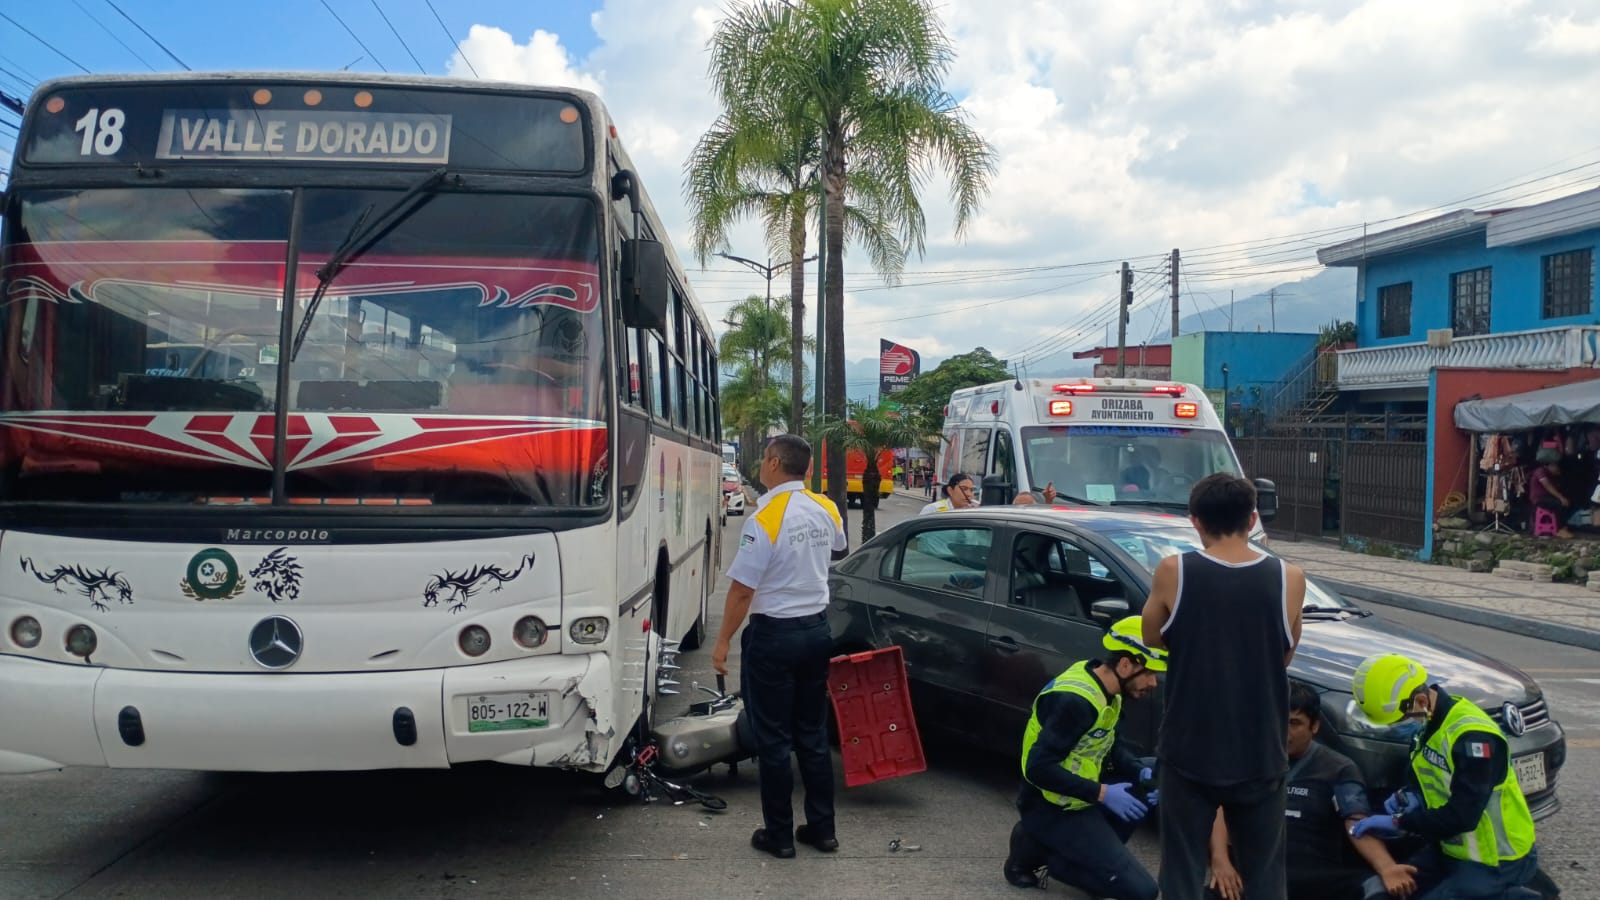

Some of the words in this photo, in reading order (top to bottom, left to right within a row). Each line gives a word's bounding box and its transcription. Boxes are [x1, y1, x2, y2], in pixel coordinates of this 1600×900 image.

[75, 108, 126, 156] 18
[180, 117, 287, 152] VALLE
[295, 121, 438, 155] DORADO
[1101, 398, 1143, 410] ORIZABA
[1091, 410, 1154, 420] AYUNTAMIENTO
[227, 528, 329, 540] Marcopolo
[471, 700, 547, 721] 805-122-W
